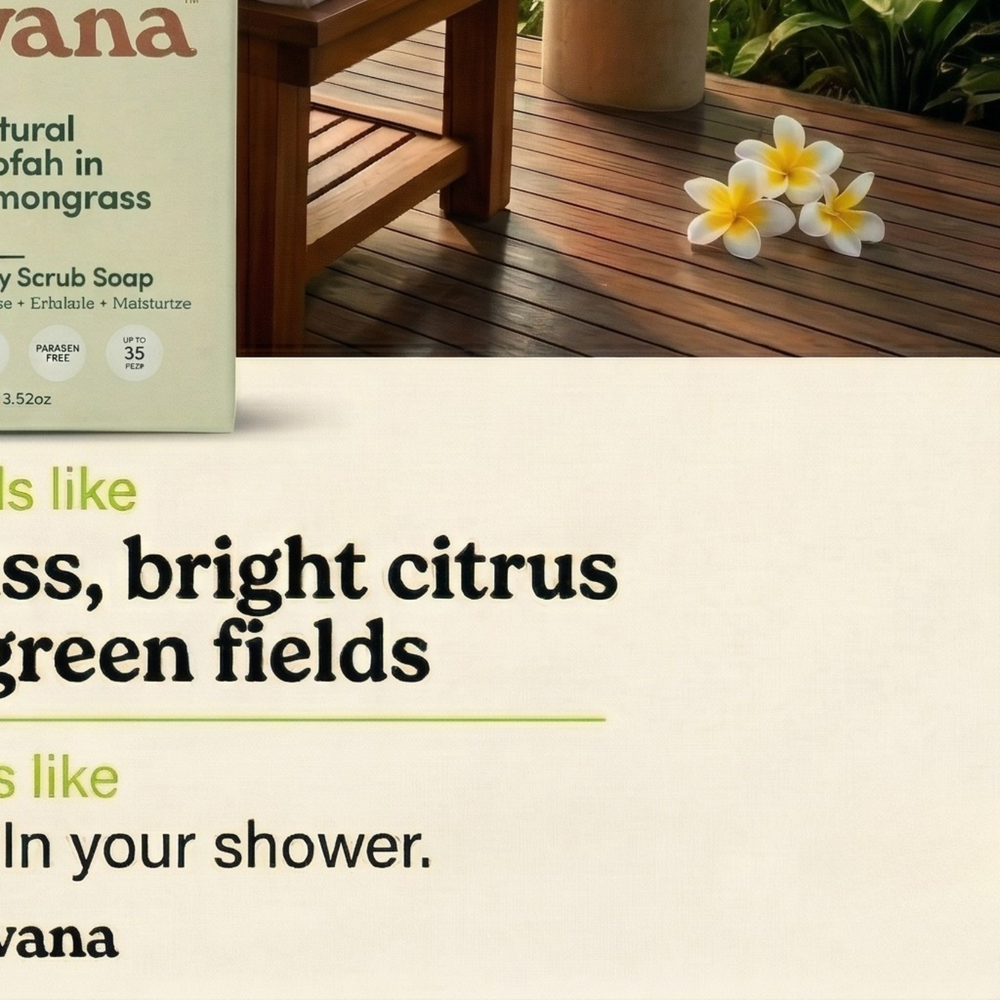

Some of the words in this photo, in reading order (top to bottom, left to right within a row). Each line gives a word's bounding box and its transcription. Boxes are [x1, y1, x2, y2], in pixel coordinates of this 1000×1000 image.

[75, 149, 103, 176] in
[17, 266, 86, 288] Scrub
[93, 267, 154, 292] Soap
[123, 336, 134, 344] UP
[135, 336, 147, 344] TO
[36, 344, 80, 353] PARASEN
[124, 346, 145, 360] 35
[46, 353, 70, 362] FREE
[2, 392, 52, 406] 3.52oz
